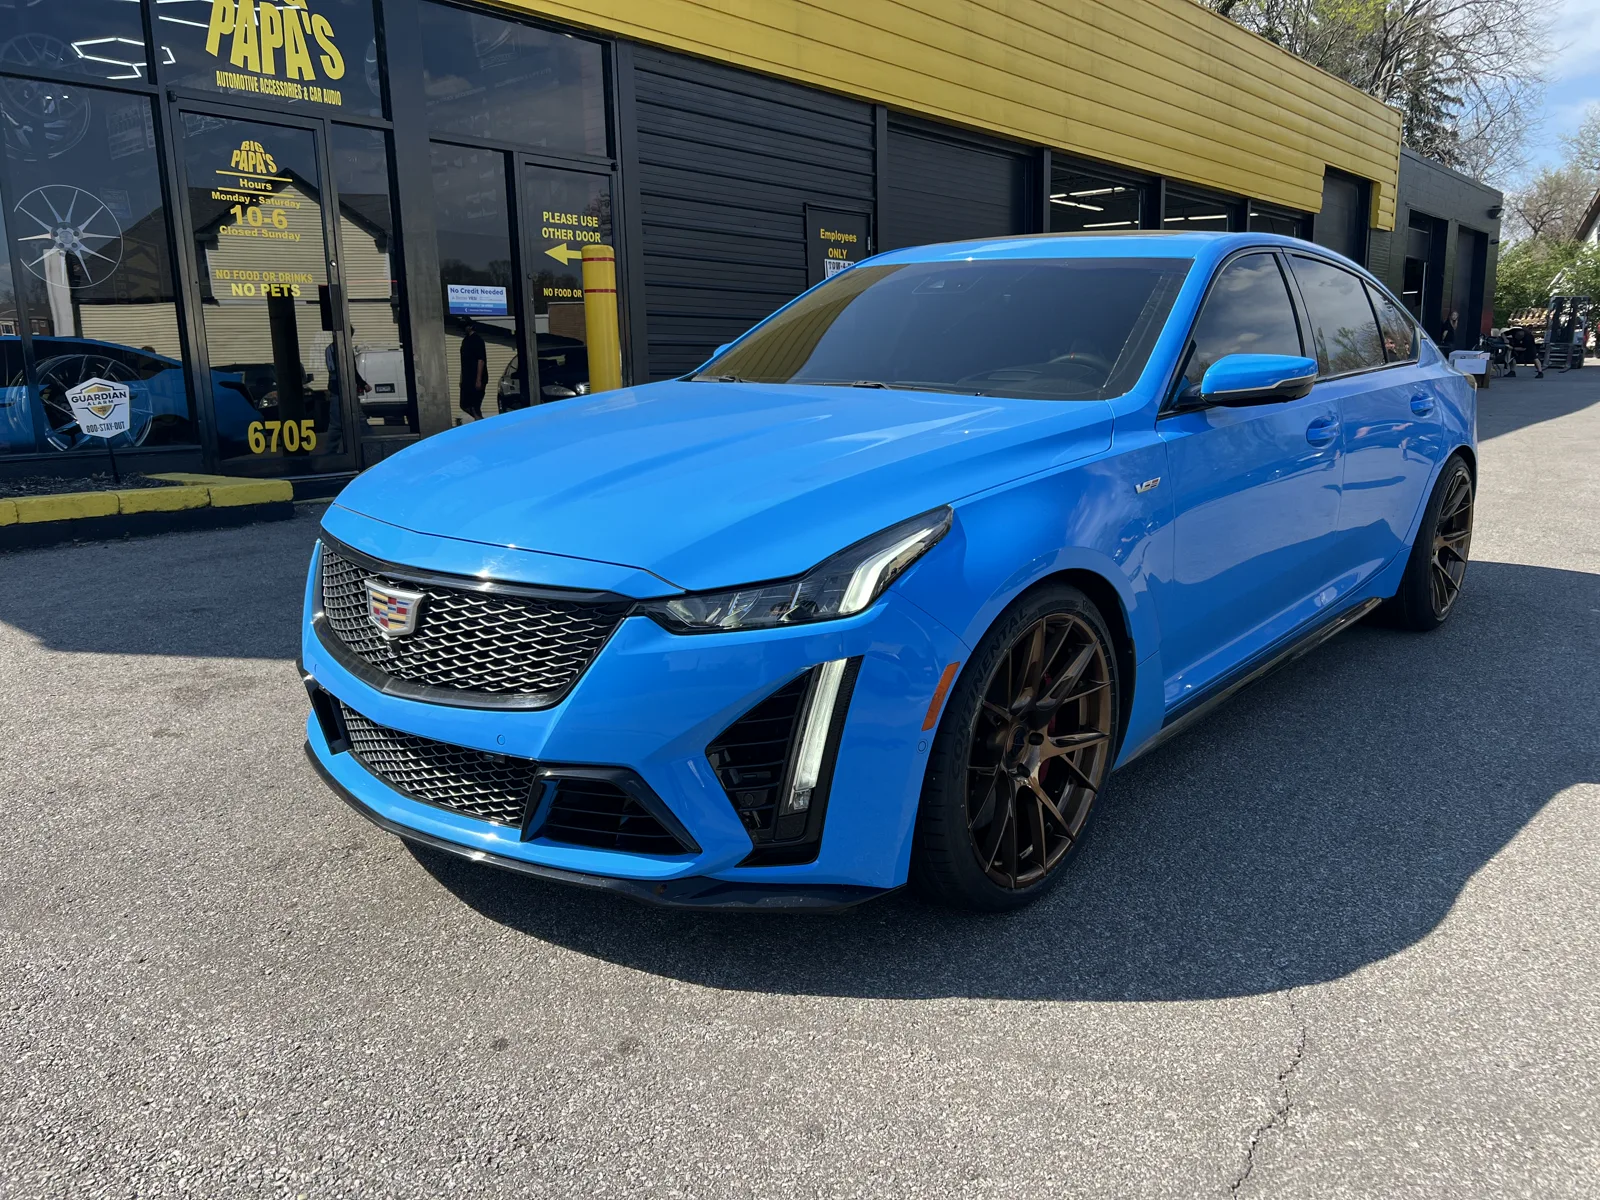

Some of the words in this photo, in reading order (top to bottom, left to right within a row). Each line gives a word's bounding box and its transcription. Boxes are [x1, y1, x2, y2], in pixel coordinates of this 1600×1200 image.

[205, 0, 346, 81] PAPA'S
[216, 70, 259, 93] AUTOMOTIVE
[260, 77, 302, 99] ACCESSORIES
[303, 88, 309, 101] &
[309, 87, 323, 103] CAR
[323, 88, 342, 106] AUDIO
[240, 140, 265, 153] BIG
[230, 149, 278, 174] PAPA'S
[239, 178, 273, 191] Hours
[211, 191, 250, 205] Monday
[258, 196, 301, 210] Saturday
[230, 204, 288, 230] 10-6
[542, 211, 579, 226] PLEASE
[580, 215, 599, 228] USE
[219, 225, 258, 238] Closed
[261, 229, 301, 243] Sunday
[541, 227, 574, 241] OTHER
[575, 230, 601, 243] DOOR
[820, 228, 857, 243] Employees
[828, 248, 847, 259] ONLY
[215, 269, 230, 280] NO
[233, 271, 260, 281] FOOD
[262, 273, 276, 283] OR
[278, 272, 313, 284] DRINKS
[231, 282, 256, 297] NO
[260, 283, 301, 297] PETS
[480, 288, 504, 296] Needed
[543, 287, 553, 297] NO
[554, 288, 572, 298] FOOD
[573, 289, 582, 298] OR
[71, 391, 127, 403] GUARDIAN
[86, 421, 125, 433] 800-STAY-OUT
[247, 419, 317, 454] 6705
[951, 607, 1030, 780] CONTINENTAL
